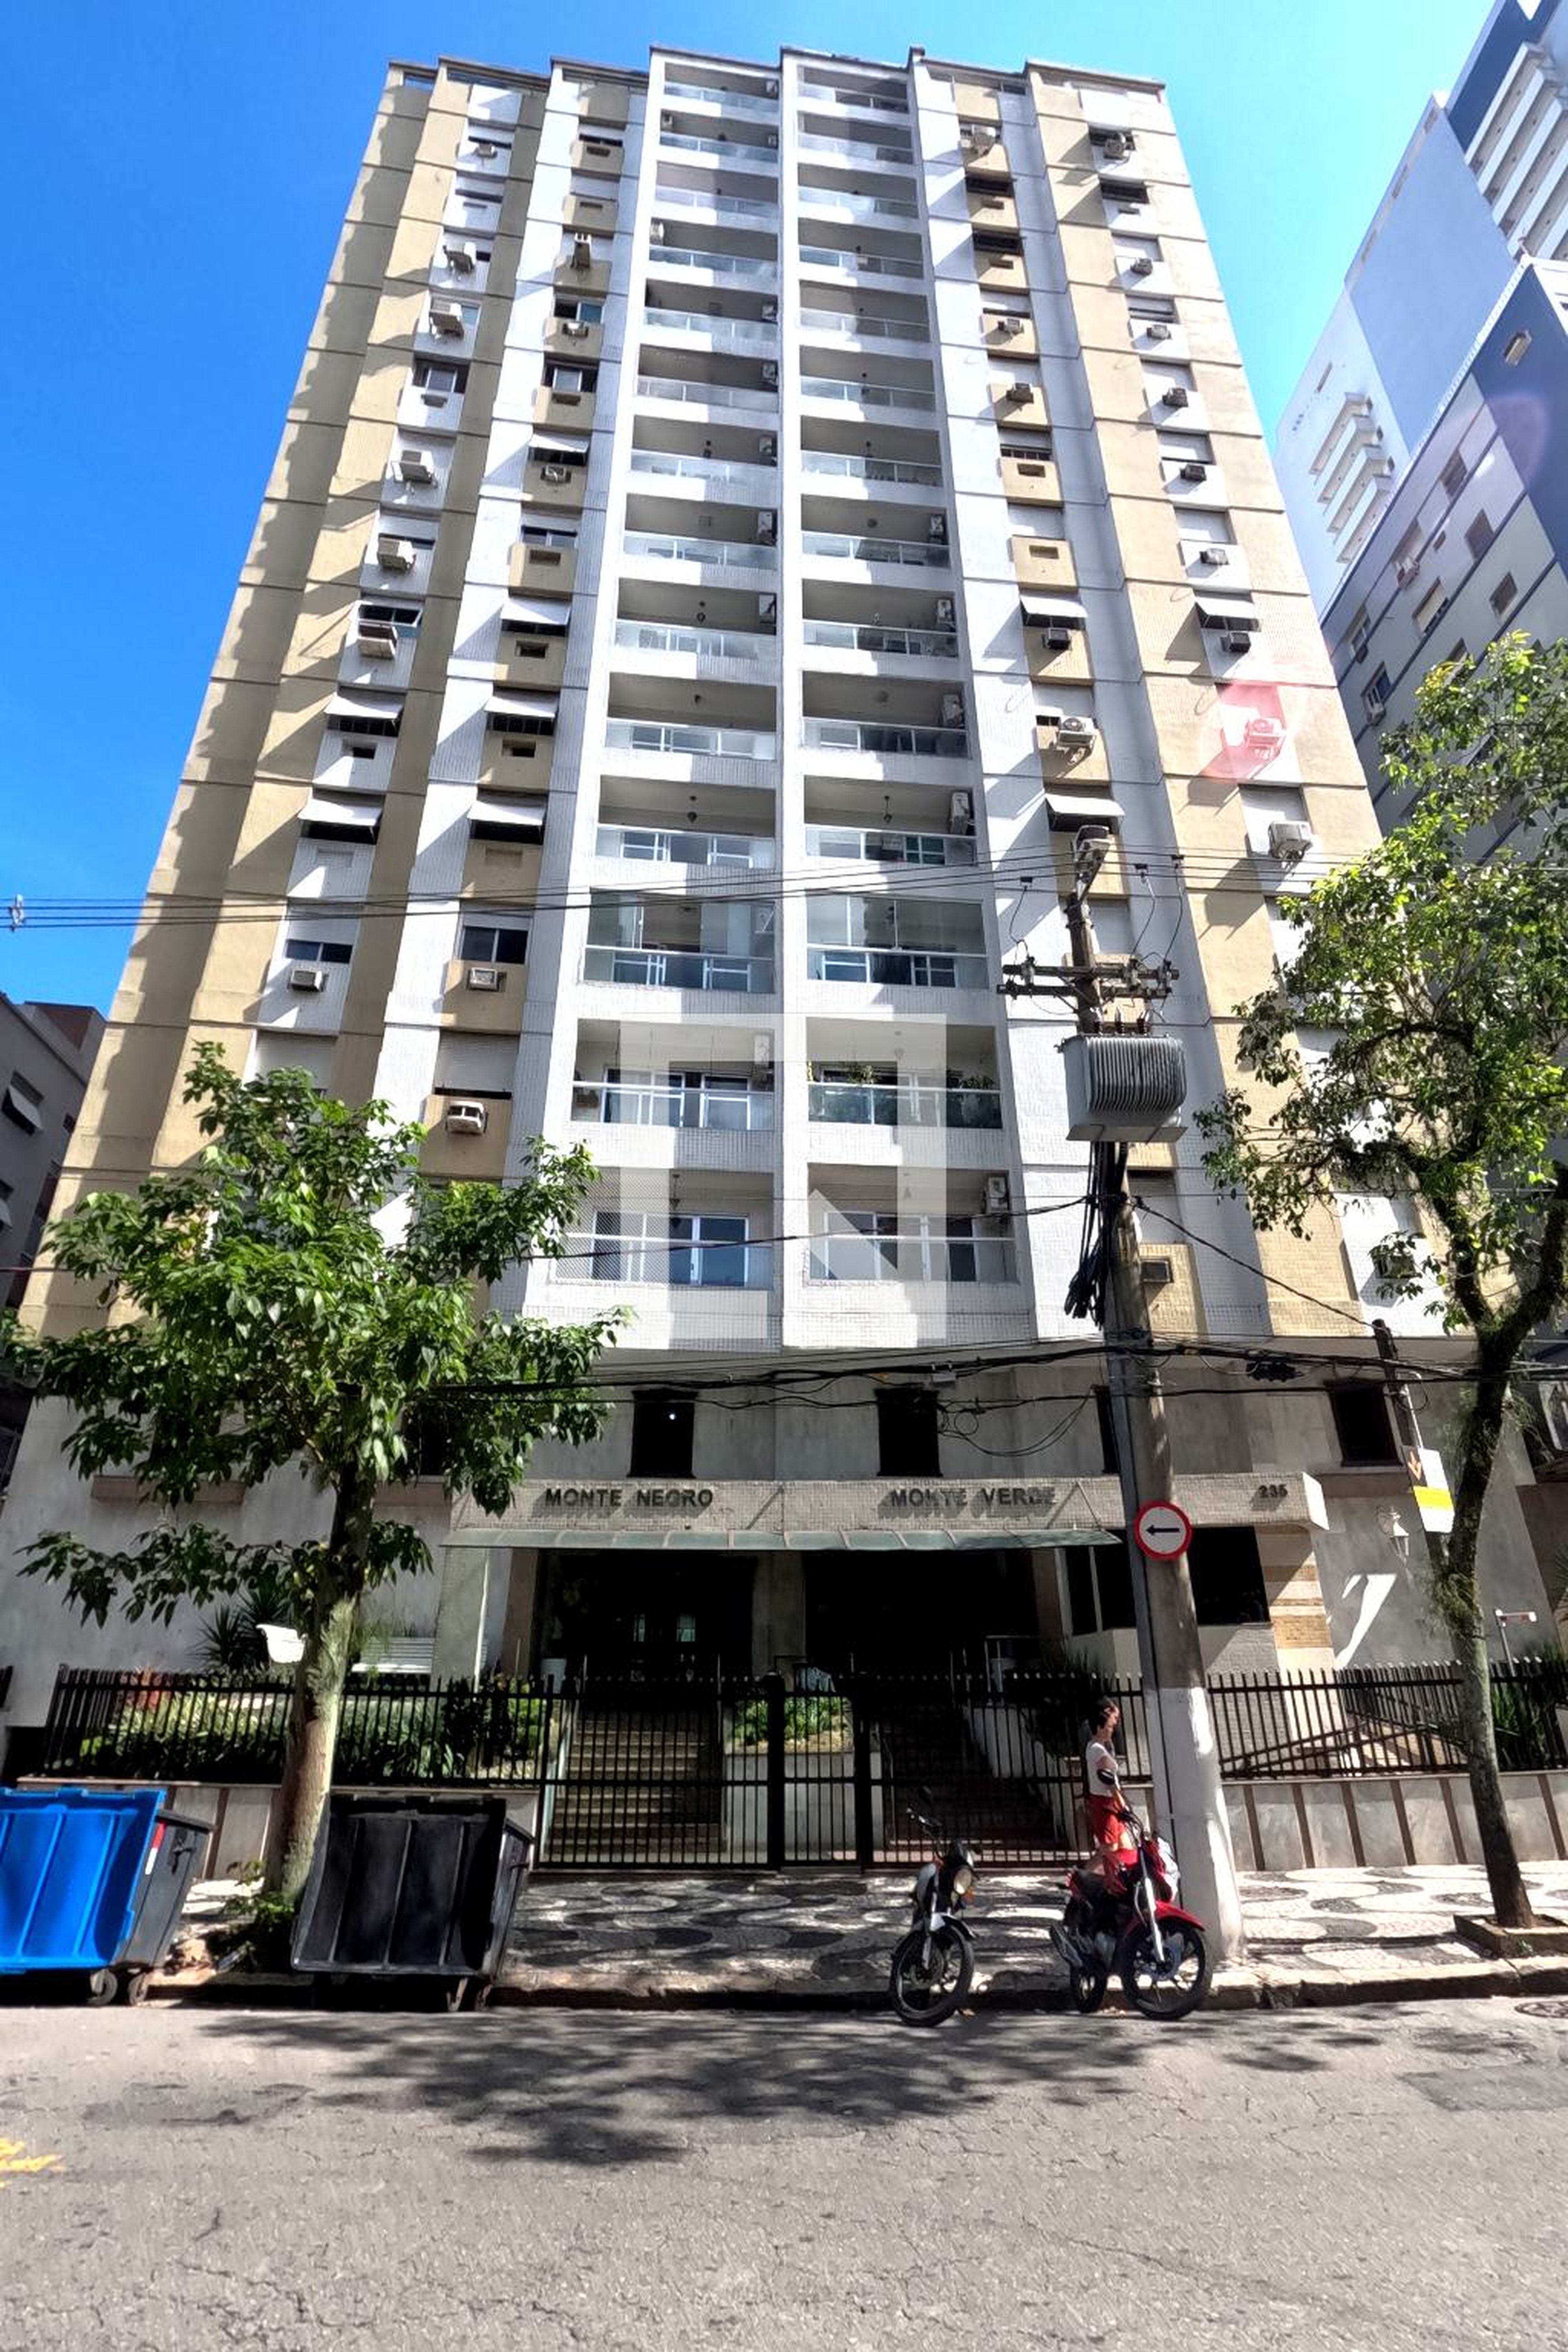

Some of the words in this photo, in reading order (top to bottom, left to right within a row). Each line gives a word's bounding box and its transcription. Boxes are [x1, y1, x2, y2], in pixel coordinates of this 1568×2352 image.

[545, 1488, 622, 1507] MONTE
[637, 1489, 713, 1507] NEGRO
[891, 1488, 968, 1507] MONTE
